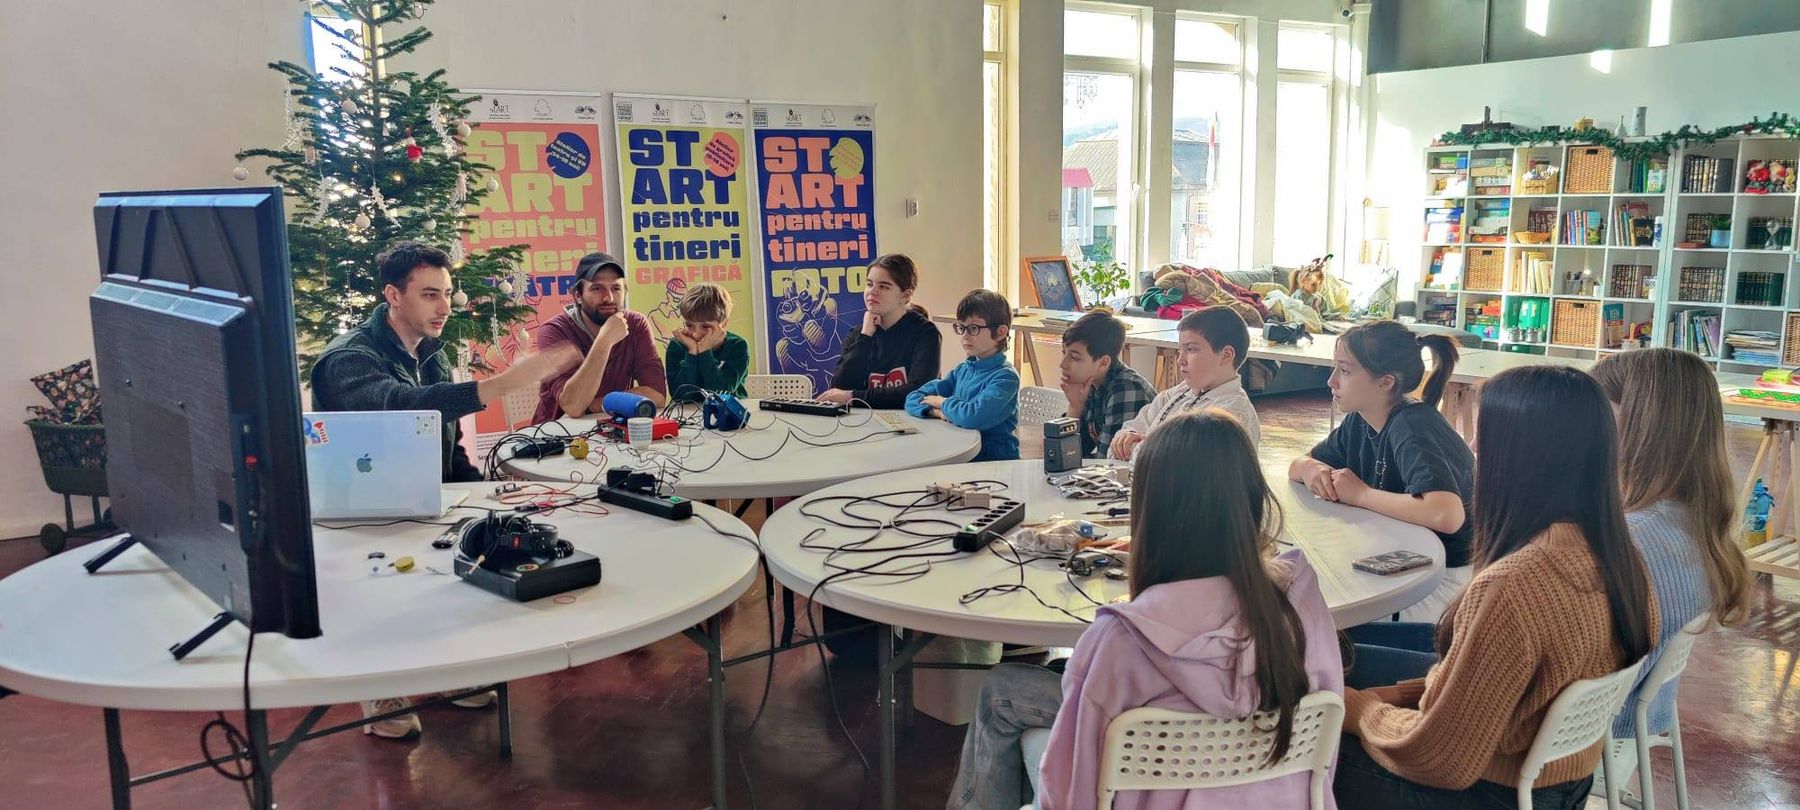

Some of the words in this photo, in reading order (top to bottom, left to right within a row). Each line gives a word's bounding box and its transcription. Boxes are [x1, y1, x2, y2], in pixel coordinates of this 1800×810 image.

[463, 130, 547, 171] ST
[628, 129, 700, 167] ST
[763, 136, 831, 173] ST
[466, 172, 593, 213] ART
[631, 168, 737, 205] ART
[765, 173, 865, 210] ART
[468, 215, 597, 244] pentru
[632, 207, 740, 233] pentru
[767, 210, 868, 236] pentru
[633, 233, 742, 262] tineri
[768, 234, 869, 263] tineri
[635, 259, 743, 285] GRAFICĂ
[771, 266, 868, 298] FOTO
